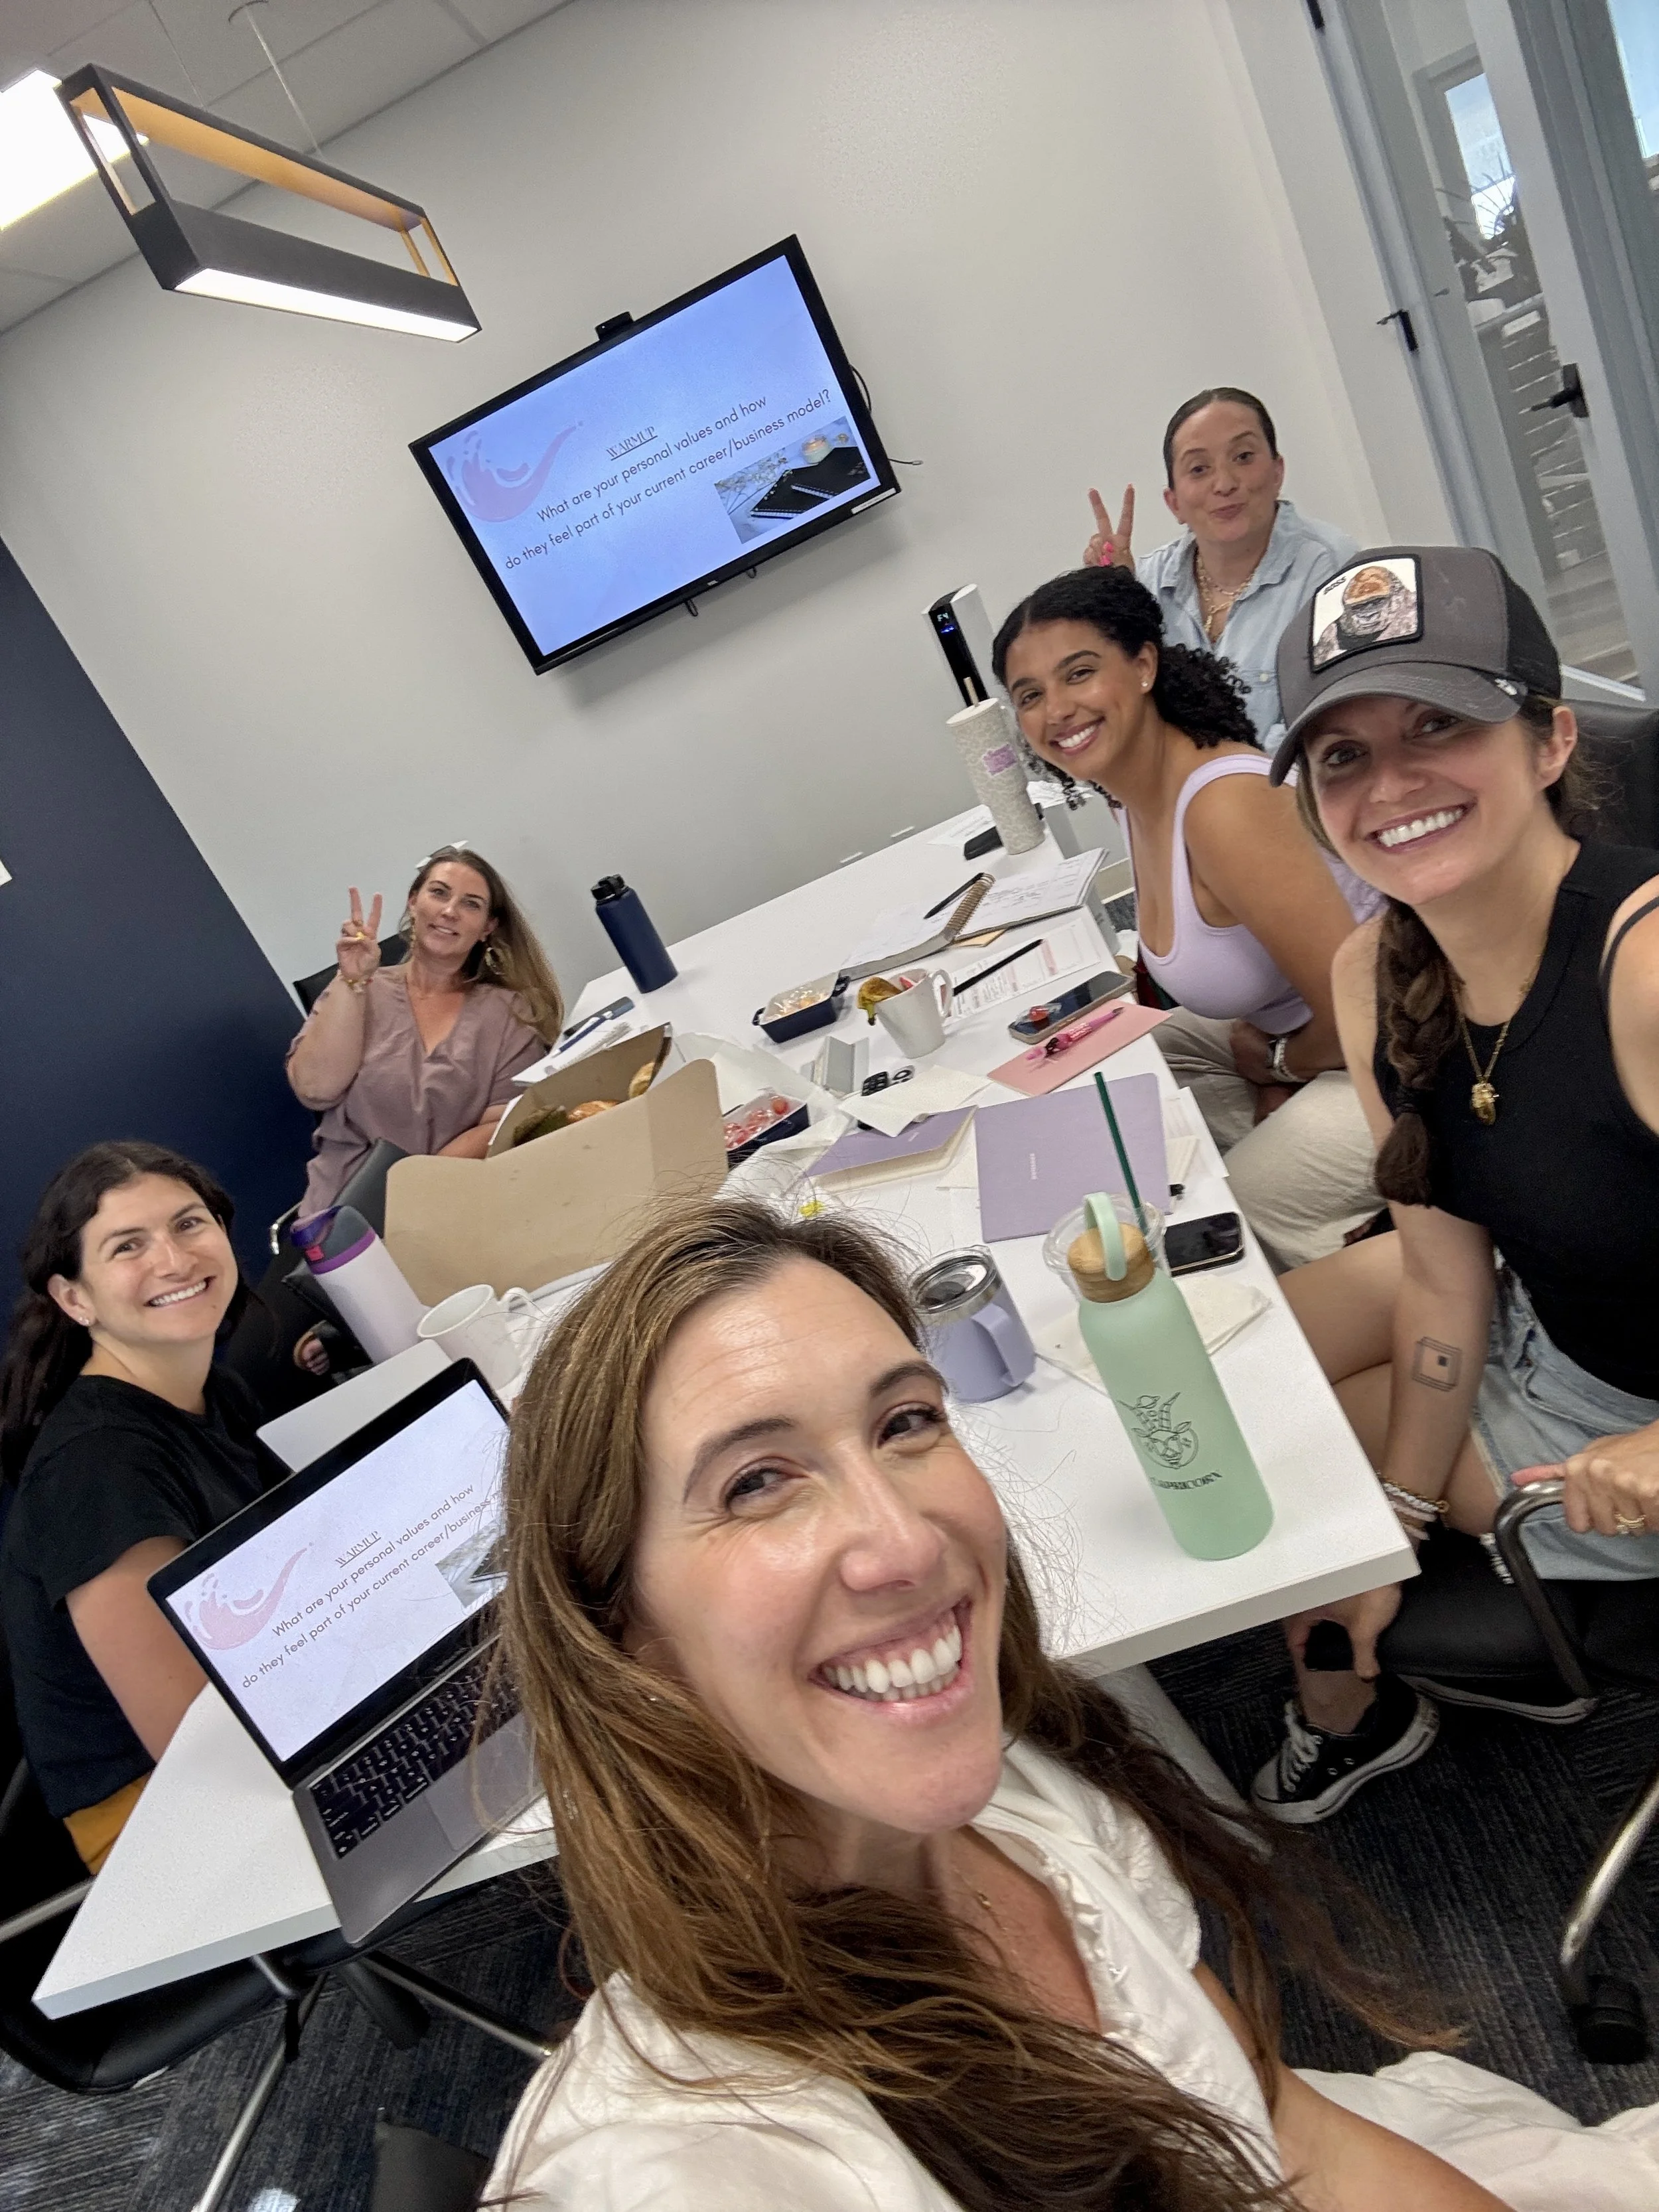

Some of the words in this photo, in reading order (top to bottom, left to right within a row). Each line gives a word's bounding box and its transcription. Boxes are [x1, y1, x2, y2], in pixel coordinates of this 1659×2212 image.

[505, 556, 521, 569] do
[522, 542, 547, 559] they
[548, 525, 573, 546] feel
[575, 513, 599, 537] part
[603, 503, 614, 519] of
[616, 493, 642, 516] your
[645, 467, 686, 497] current
[689, 418, 785, 474] career/business
[787, 389, 831, 423] model?
[537, 500, 569, 522] What
[572, 490, 592, 505] are
[593, 475, 618, 498] your
[622, 443, 673, 483] personal
[674, 425, 712, 451] values
[715, 407, 739, 429] and
[739, 397, 766, 417] how
[606, 426, 656, 459] WARMUP
[272, 1611, 303, 1636] What
[306, 1598, 324, 1613] are
[325, 1578, 348, 1602] your
[350, 1541, 396, 1583] personal
[396, 1519, 430, 1545] values
[431, 1500, 451, 1520] and
[450, 1484, 474, 1505] how
[335, 1530, 380, 1567] WARMUP
[243, 1675, 258, 1688] do
[259, 1655, 284, 1675] they
[284, 1634, 308, 1655] feel
[309, 1617, 332, 1641] part
[334, 1604, 346, 1619] of
[348, 1588, 370, 1611] your
[373, 1559, 409, 1590] current
